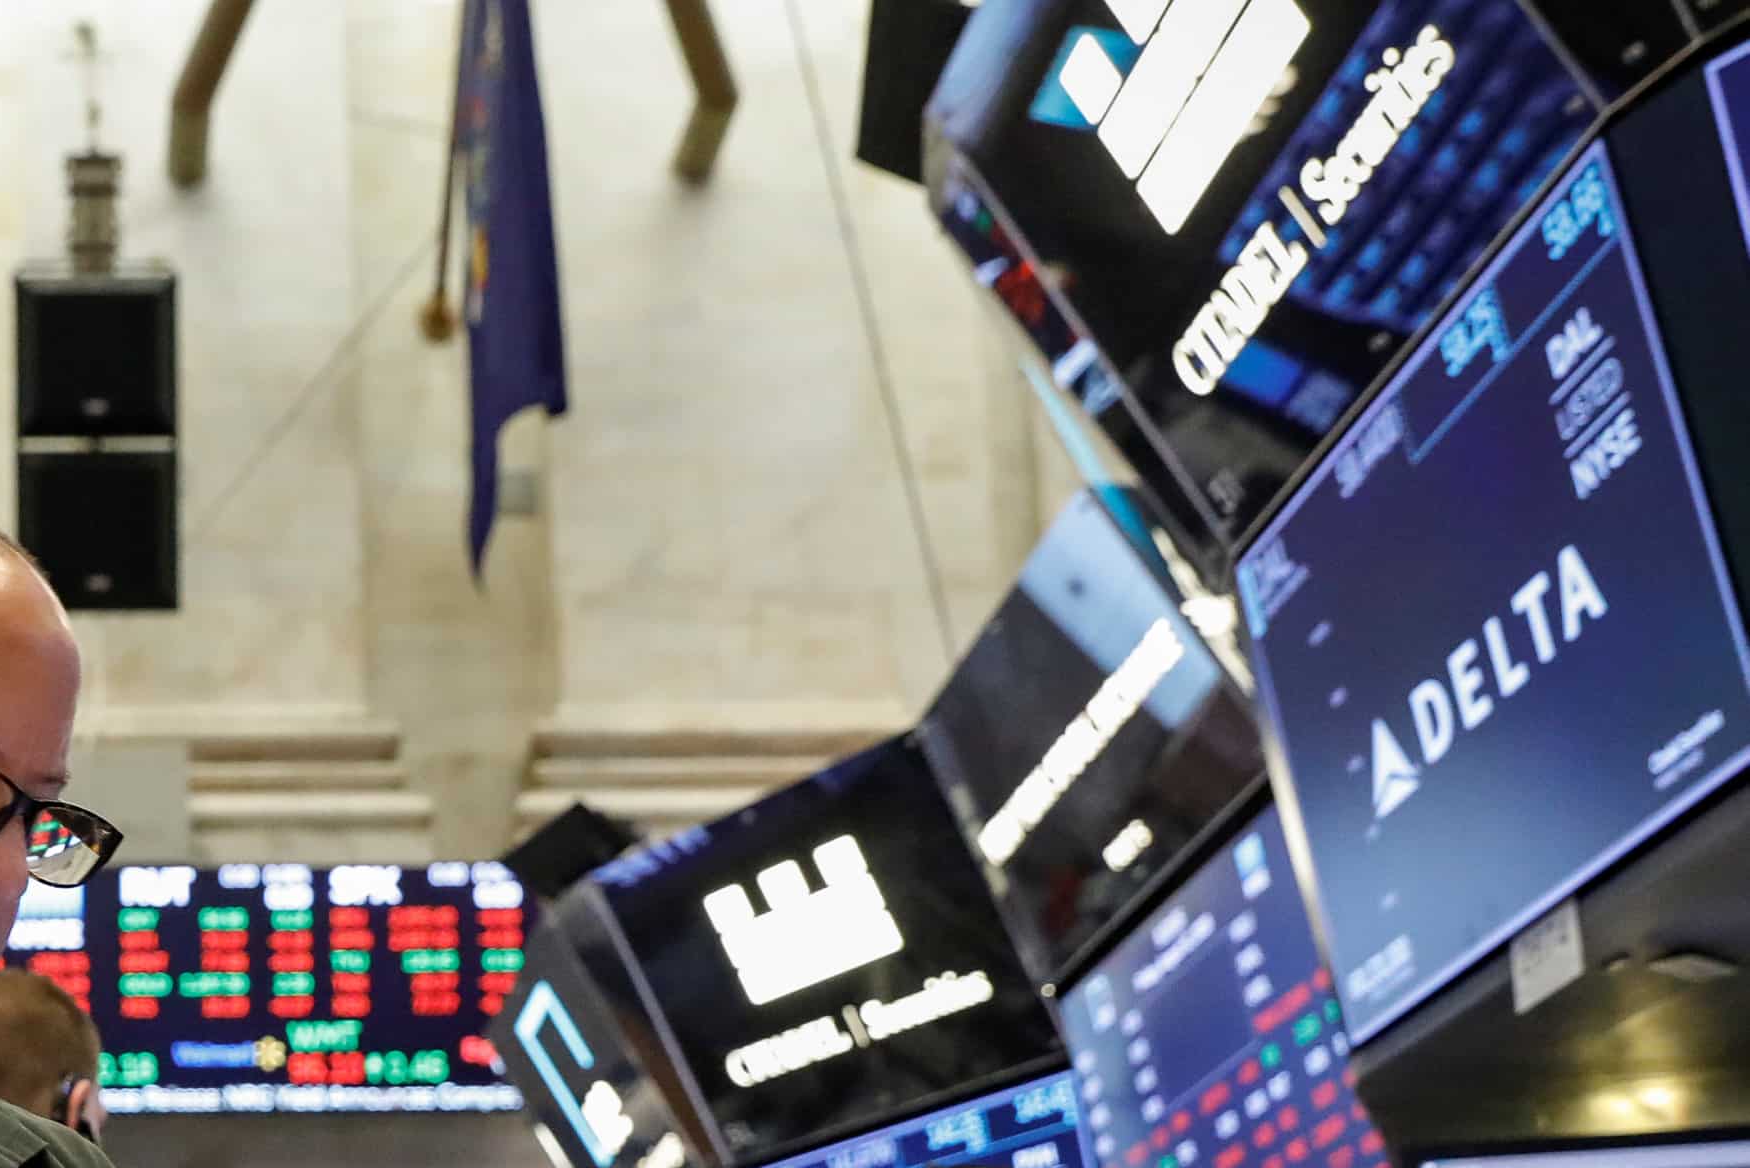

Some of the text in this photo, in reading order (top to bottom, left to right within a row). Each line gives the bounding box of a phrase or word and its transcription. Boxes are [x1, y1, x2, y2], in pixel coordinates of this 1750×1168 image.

[1172, 221, 1309, 396] CITADEL
[1569, 408, 1643, 500] NYSE
[1406, 543, 1609, 766] DELTA
